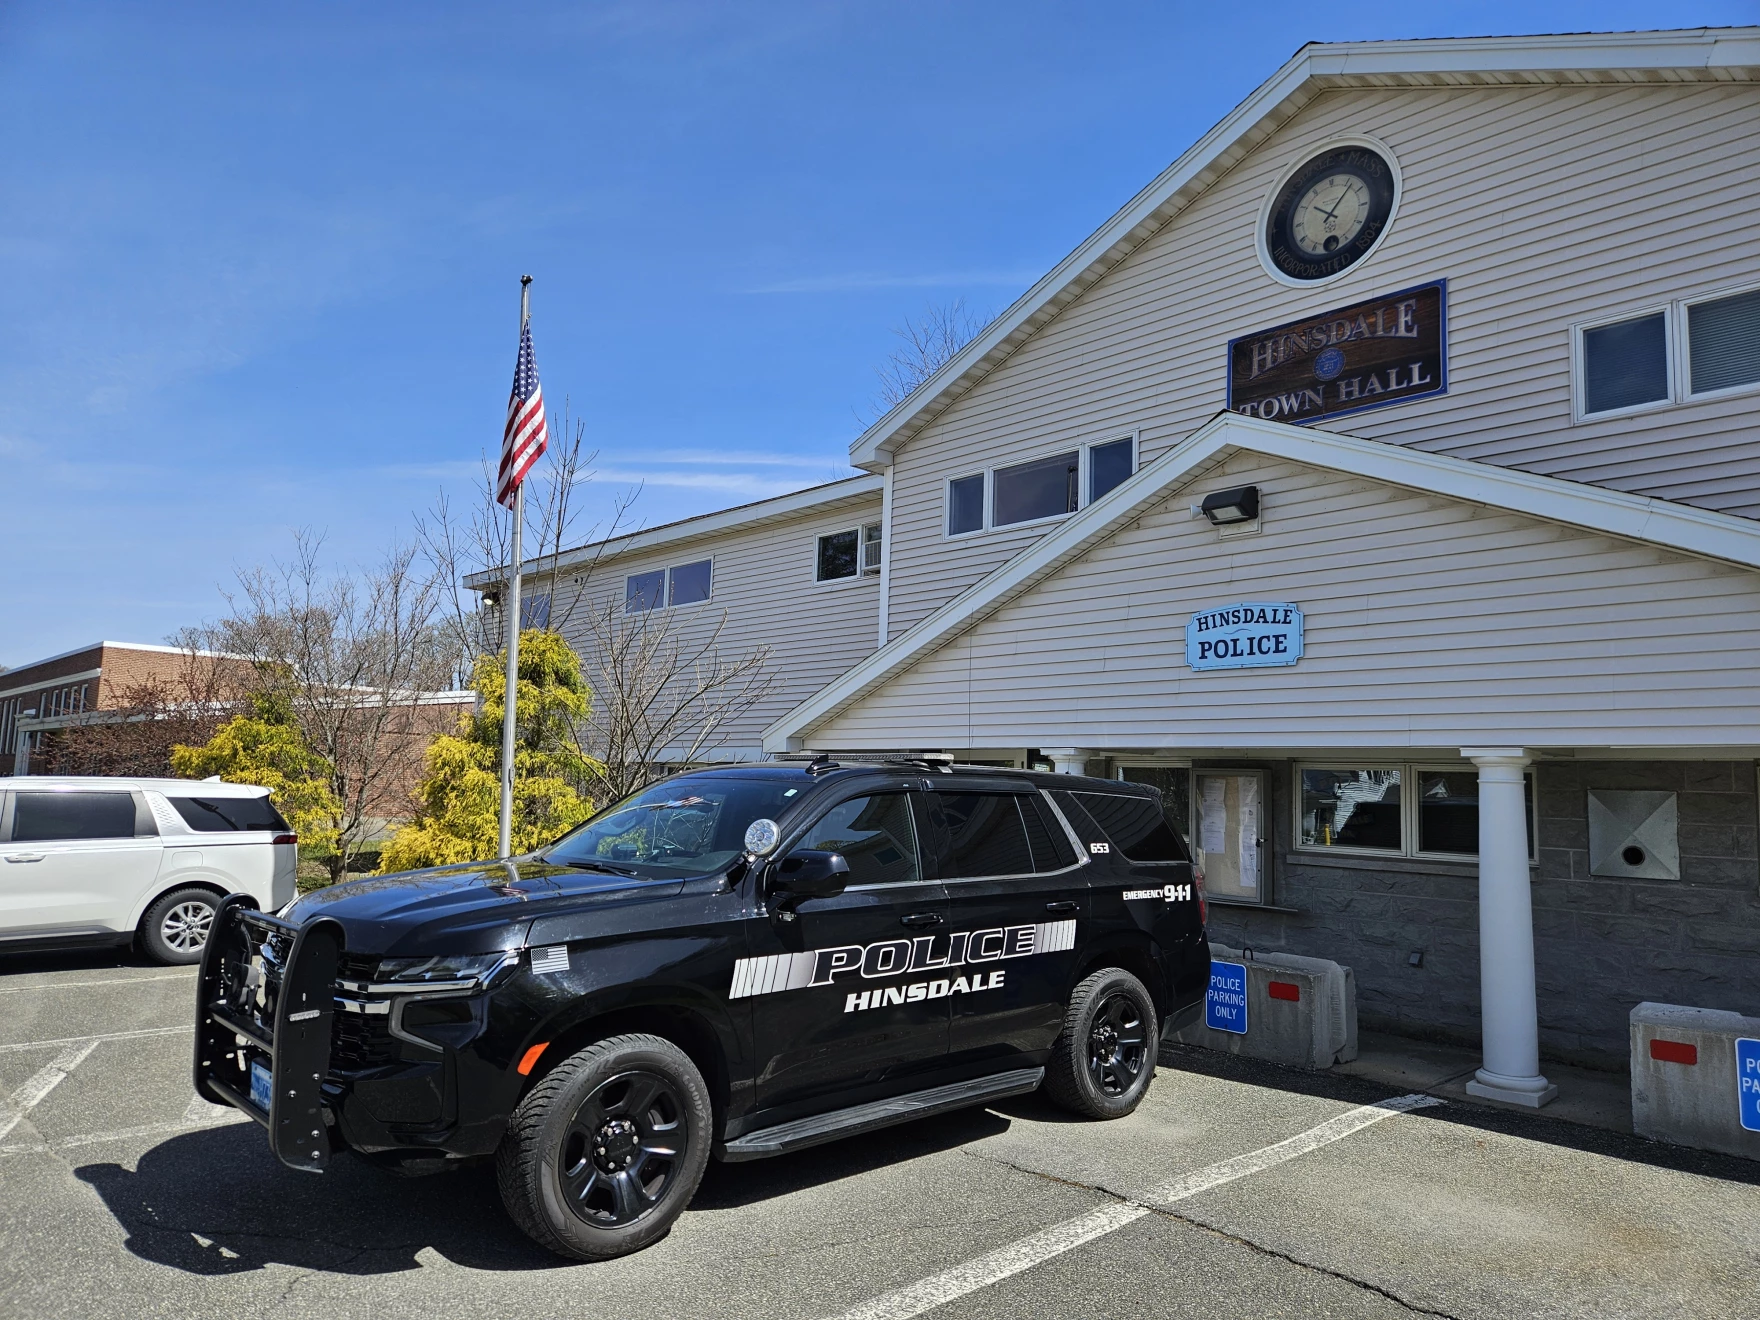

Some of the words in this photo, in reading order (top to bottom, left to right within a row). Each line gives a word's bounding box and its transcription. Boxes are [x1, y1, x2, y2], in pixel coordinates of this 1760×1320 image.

[1274, 246, 1351, 277] INCORPORATED
[1356, 220, 1381, 250] 1804
[1250, 299, 1418, 380] HINSDALE
[1239, 385, 1325, 419] TOWN
[1337, 362, 1431, 402] HALL
[1196, 608, 1293, 632] HINSDALE
[1198, 634, 1288, 660] POLICE
[1122, 889, 1164, 901] EMERGENCY
[807, 924, 1036, 987] POLICE
[844, 970, 1006, 1013] HINSDALE
[1210, 975, 1241, 991] POLICE
[1208, 989, 1245, 1007] PARKING
[1215, 1005, 1238, 1020] ONLY
